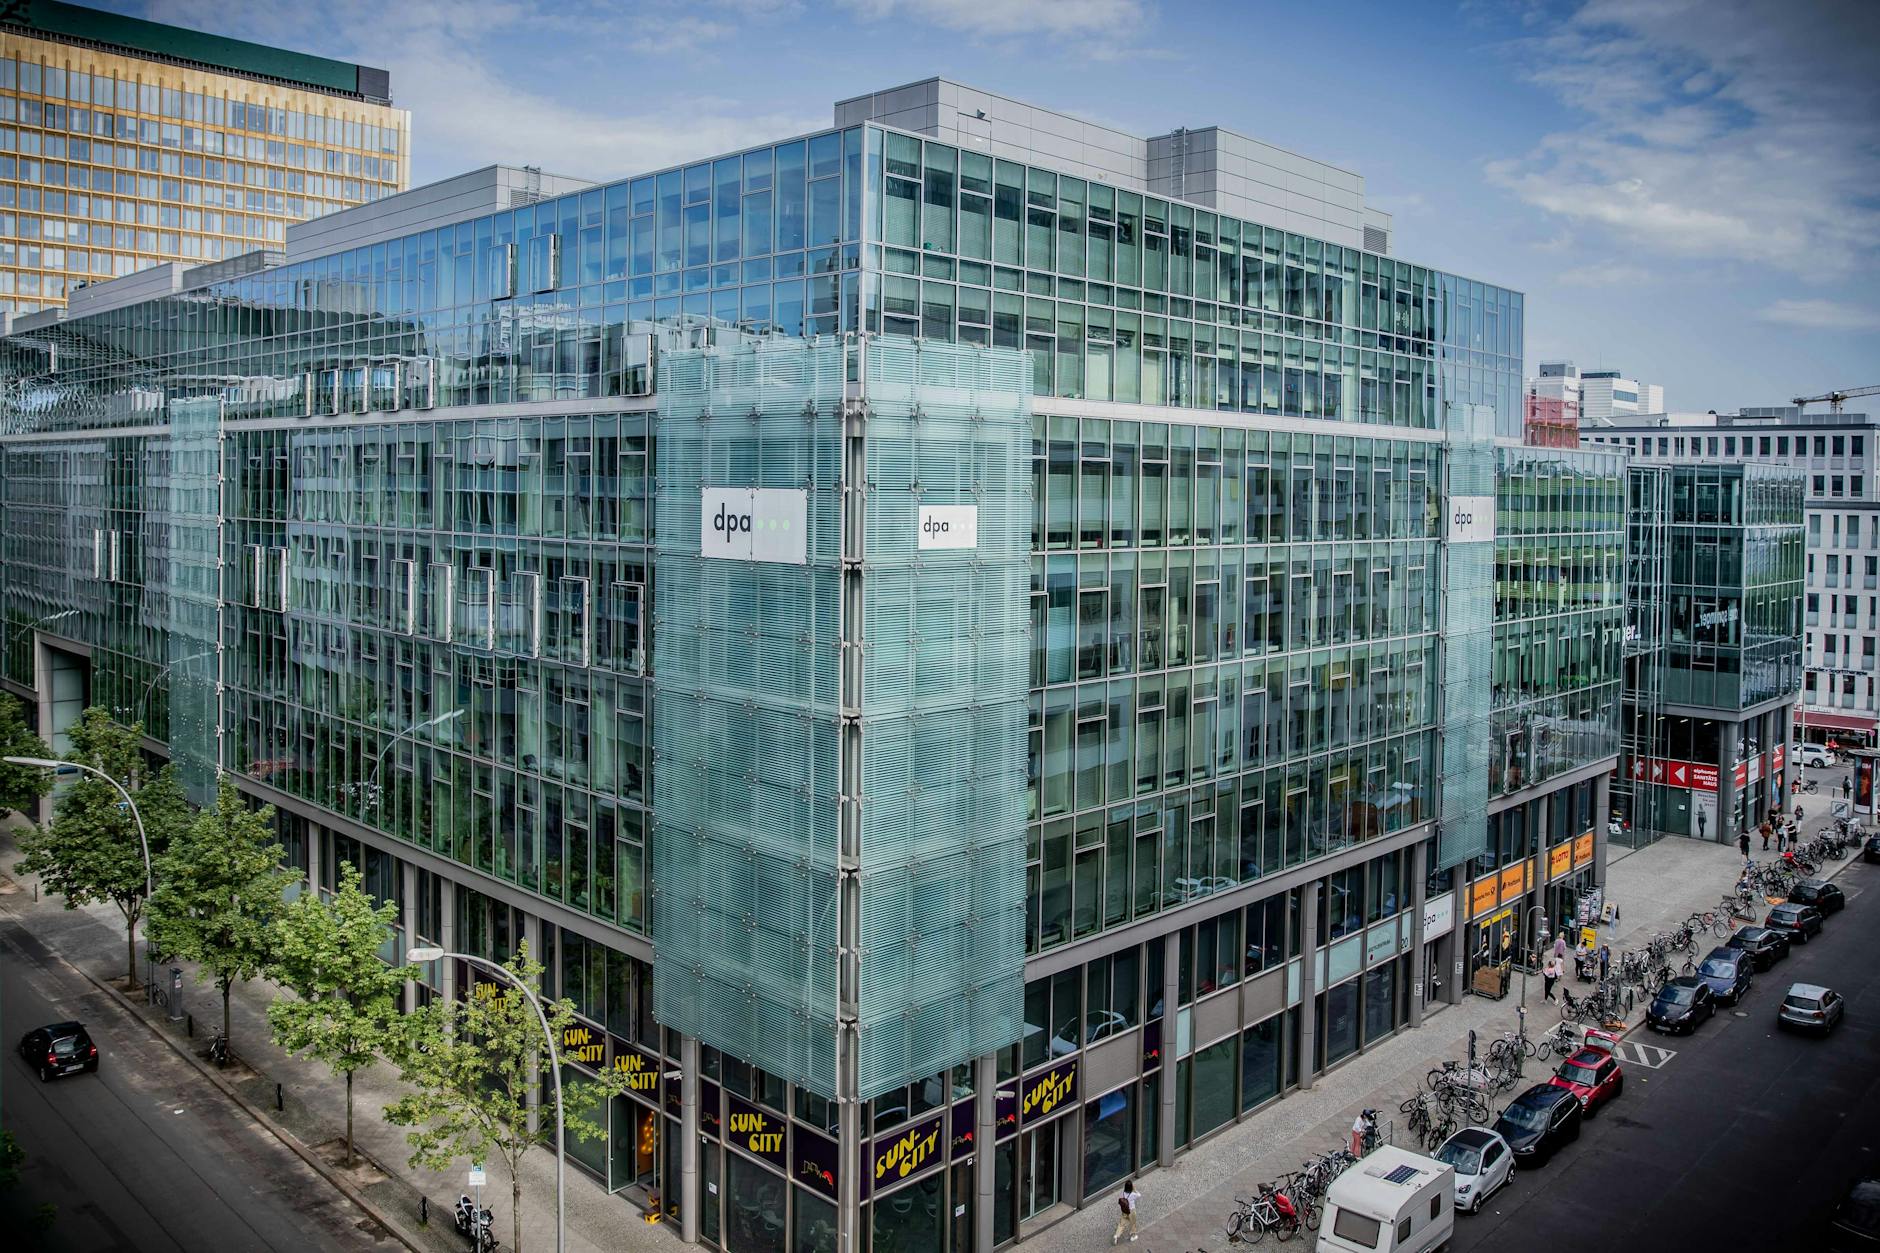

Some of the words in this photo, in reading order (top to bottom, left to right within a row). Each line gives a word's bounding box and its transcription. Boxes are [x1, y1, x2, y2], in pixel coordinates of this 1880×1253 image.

[713, 502, 751, 543] dpa
[923, 515, 949, 539] dpa
[1454, 505, 1472, 533] dpa
[1556, 850, 1568, 863] LOTTO
[1424, 912, 1436, 931] dpa
[563, 1028, 592, 1046] SUN-
[577, 1045, 604, 1062] CITY
[614, 1054, 645, 1073] SUN-
[630, 1071, 658, 1090] CITY
[1023, 1071, 1060, 1115] SUN-
[1042, 1070, 1075, 1114] CITY
[729, 1112, 767, 1133] SUN-
[749, 1133, 784, 1152] CITY
[876, 1129, 921, 1179] SUN-
[899, 1129, 939, 1178] CITY
